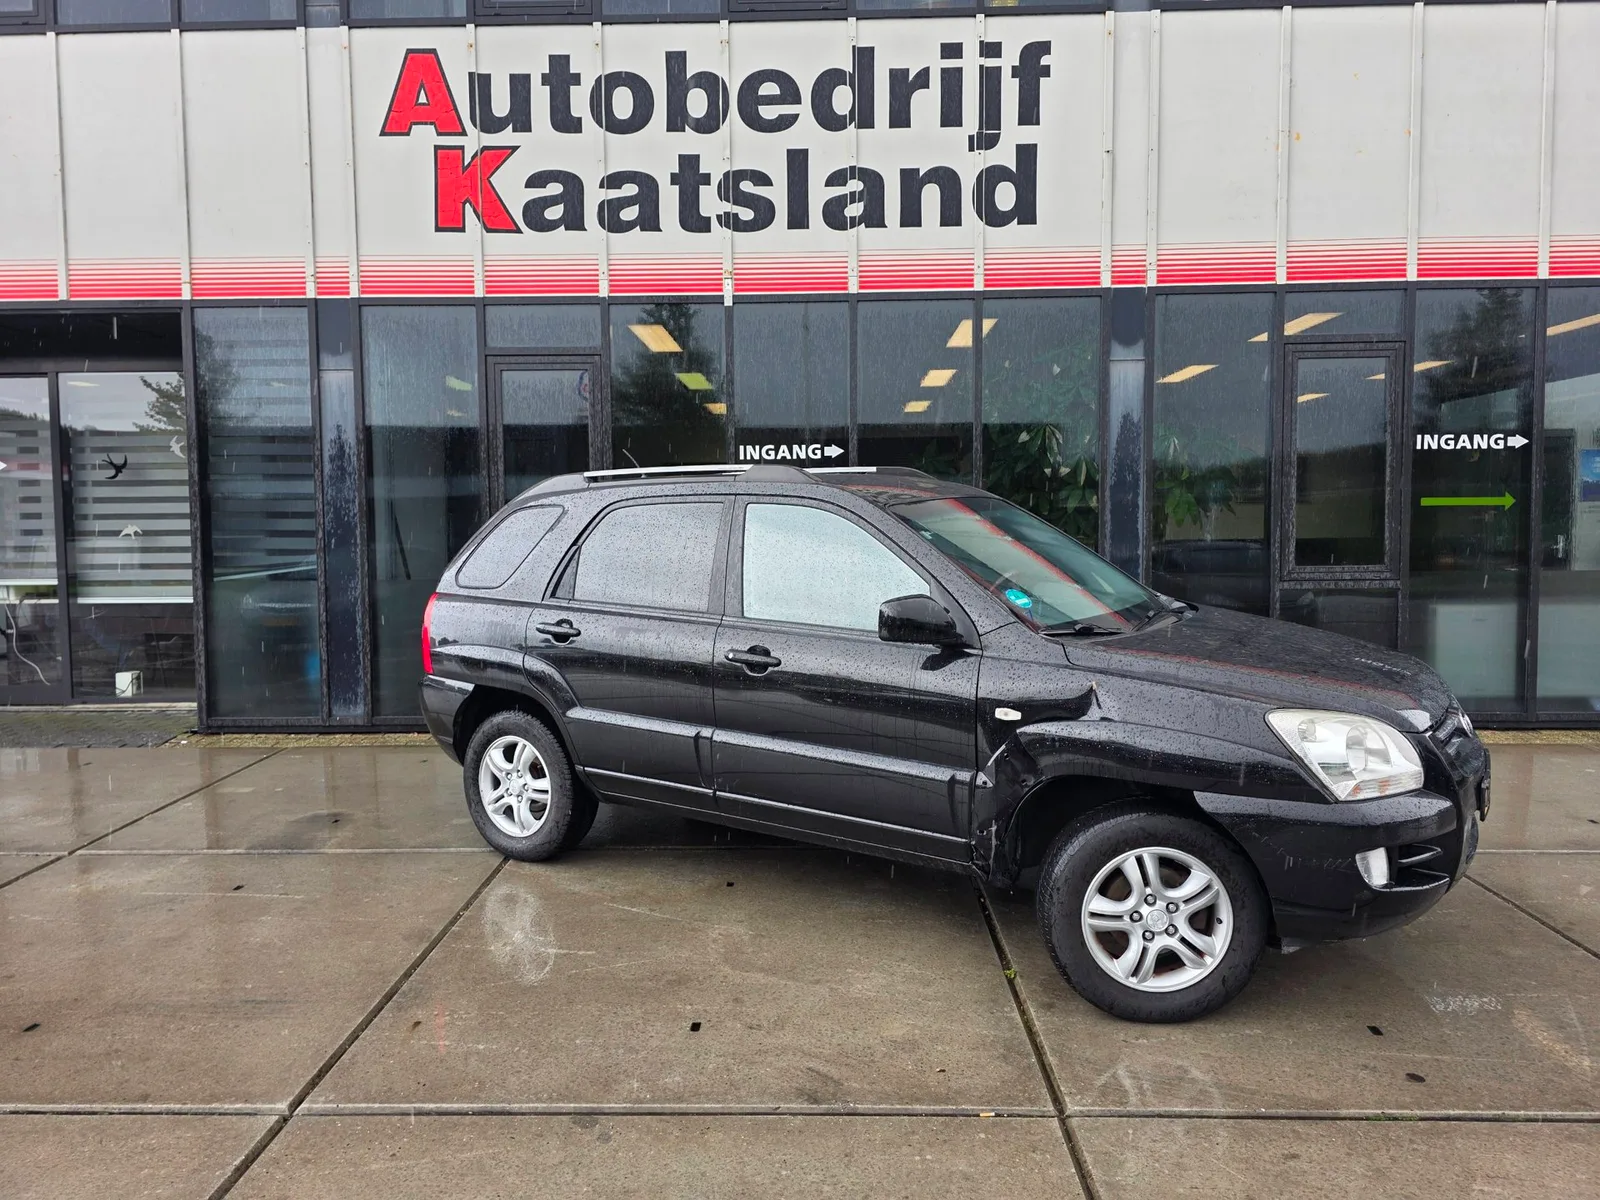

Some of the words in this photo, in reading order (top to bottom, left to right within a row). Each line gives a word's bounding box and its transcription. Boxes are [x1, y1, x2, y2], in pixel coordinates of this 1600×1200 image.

[379, 40, 1052, 152] Autobedrijf
[434, 143, 1038, 234] Kaatsland
[738, 443, 822, 461] INGANG
[1415, 433, 1505, 451] INGANG
